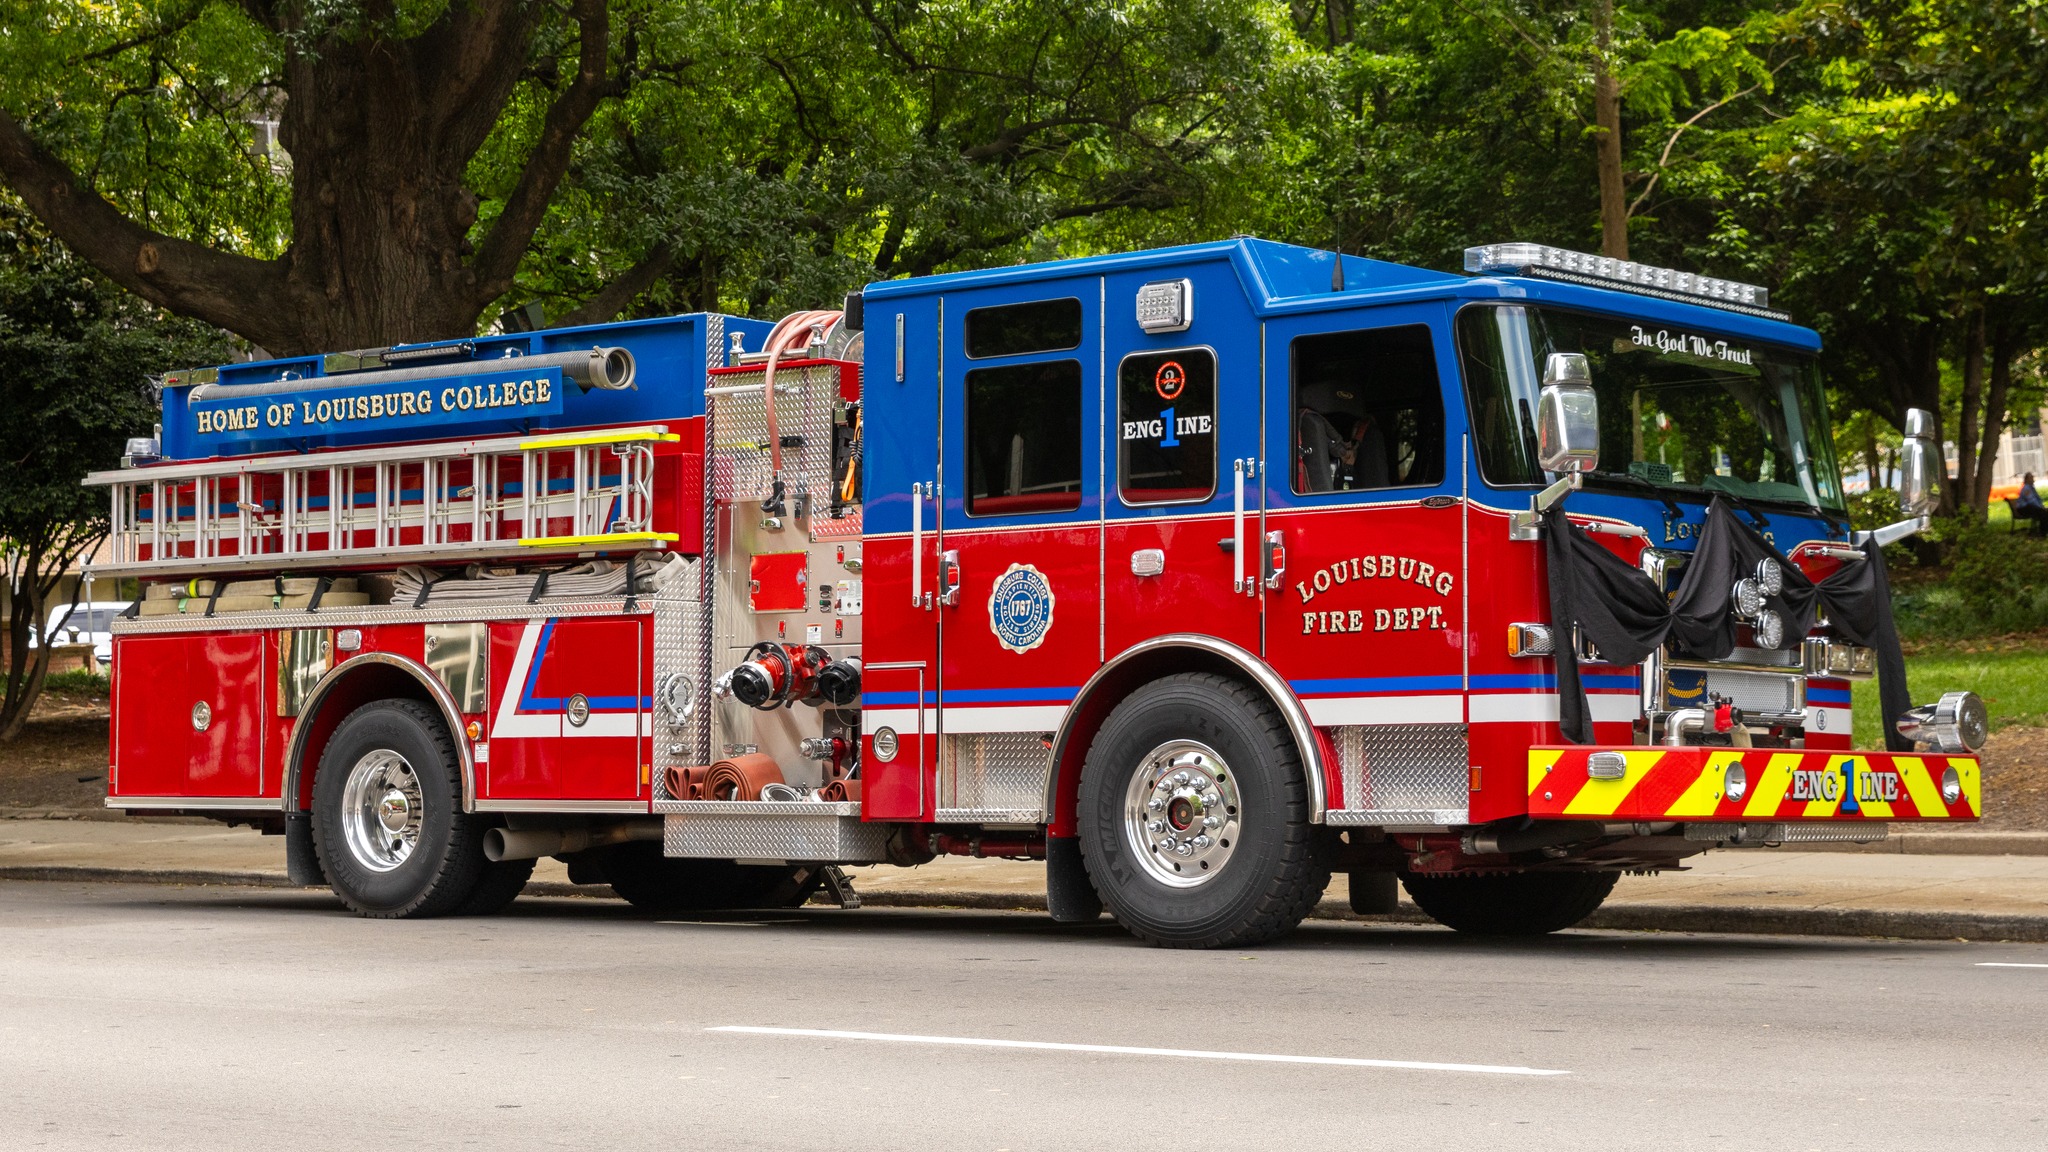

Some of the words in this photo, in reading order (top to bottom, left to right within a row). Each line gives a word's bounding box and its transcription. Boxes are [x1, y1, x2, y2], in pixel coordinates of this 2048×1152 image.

[1631, 325, 1653, 347] In
[1655, 330, 1688, 354] God
[1689, 335, 1714, 358] We
[1715, 340, 1753, 365] Trust
[197, 406, 258, 433] HOME
[266, 404, 295, 427] OF
[303, 389, 433, 424] LOUISBURG
[440, 378, 552, 412] COLLEGE
[995, 572, 1024, 603] LOUISBURG
[1027, 574, 1048, 601] COLLEGE
[1296, 555, 1454, 603] LOUISBURG
[998, 622, 1016, 644] NORTH
[1018, 620, 1047, 645] CAROLINA
[1302, 610, 1363, 634] FIRE
[1374, 606, 1447, 631] DEPT.
